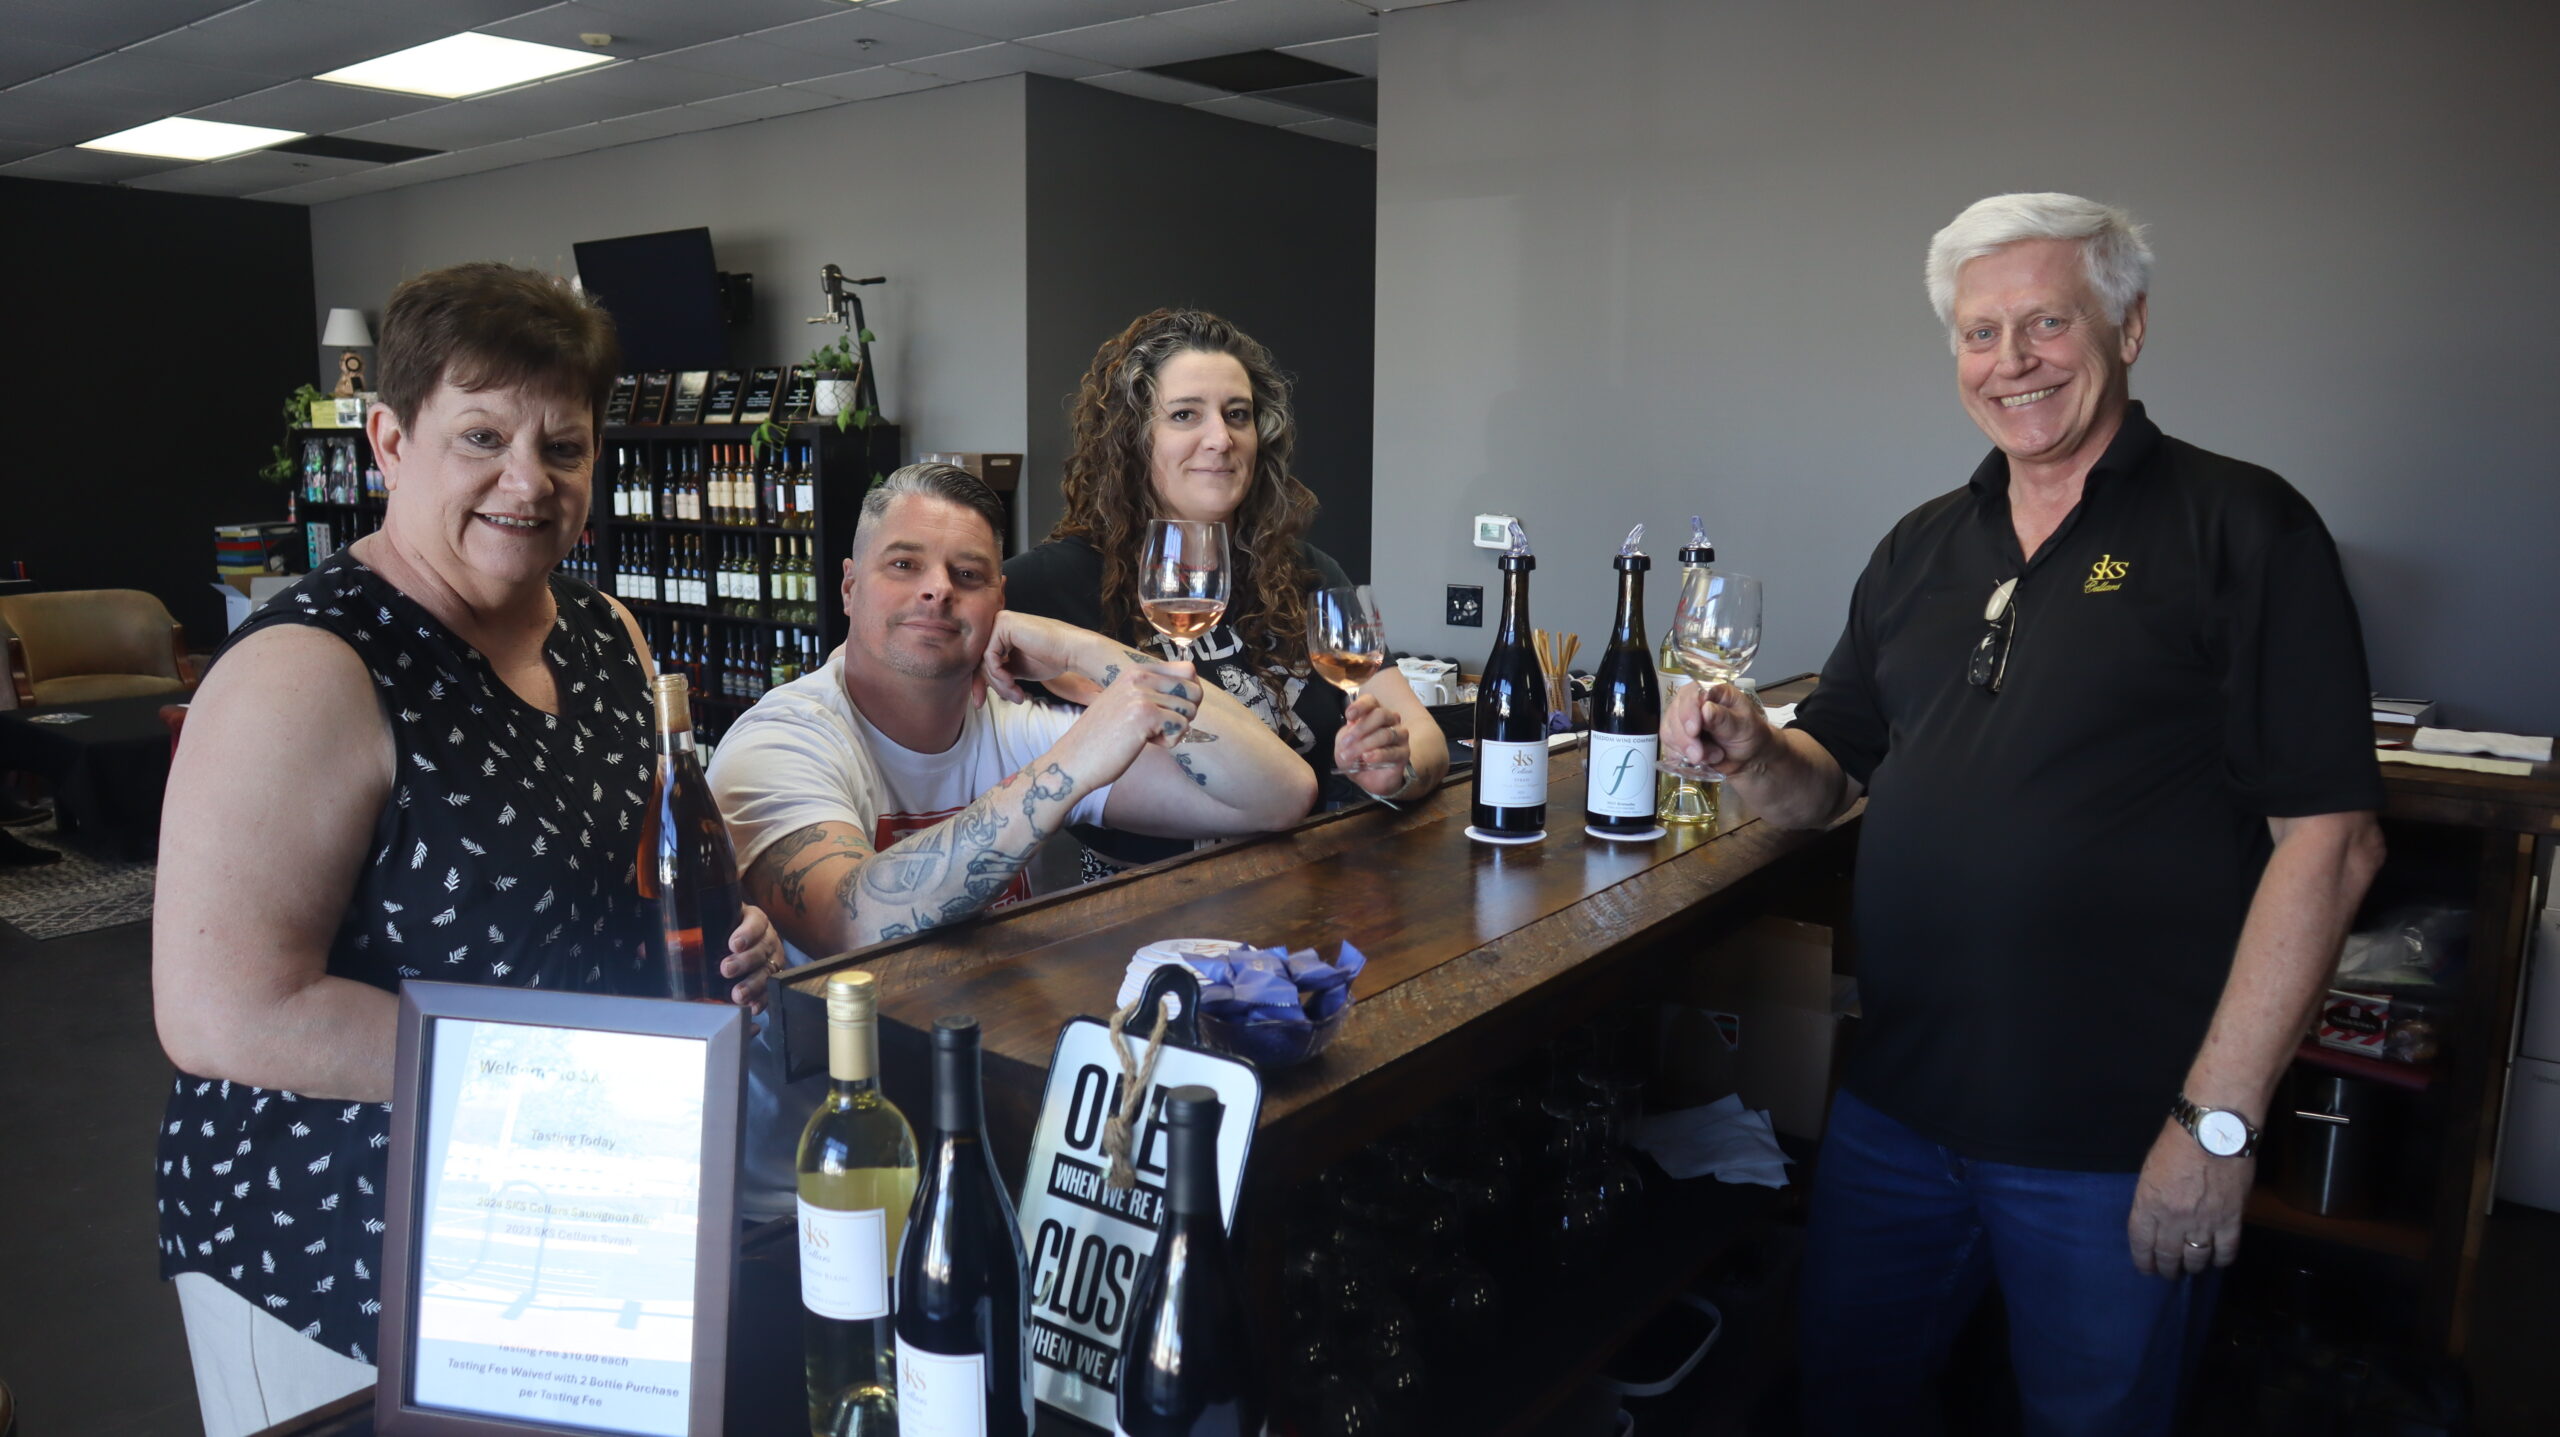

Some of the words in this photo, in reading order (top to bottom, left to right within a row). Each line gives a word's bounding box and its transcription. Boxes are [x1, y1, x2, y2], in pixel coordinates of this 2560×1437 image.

[1064, 1063, 1226, 1177] OPE
[530, 1129, 577, 1147] Tasting
[579, 1134, 617, 1151] Today
[1054, 1162, 1100, 1202] WHEN
[505, 1200, 528, 1212] SKS
[529, 1202, 569, 1216] Cellars
[571, 1207, 630, 1223] Sauvignon
[632, 1213, 660, 1226] Bla
[534, 1226, 555, 1239] SKS
[557, 1228, 598, 1243] Cellars
[1031, 1218, 1148, 1337] CLOS
[561, 1351, 599, 1363] $10.00
[600, 1356, 629, 1367] each
[1075, 1343, 1107, 1380] WE
[448, 1358, 487, 1375] Tasting
[488, 1363, 508, 1376] Fee
[511, 1366, 552, 1381] Waived
[554, 1372, 578, 1385] with
[580, 1375, 588, 1386] 2
[589, 1377, 624, 1391] Bottle
[625, 1381, 680, 1398] Purchase
[518, 1388, 537, 1399] per
[540, 1389, 580, 1406] Tasting
[582, 1394, 603, 1407] Fee
